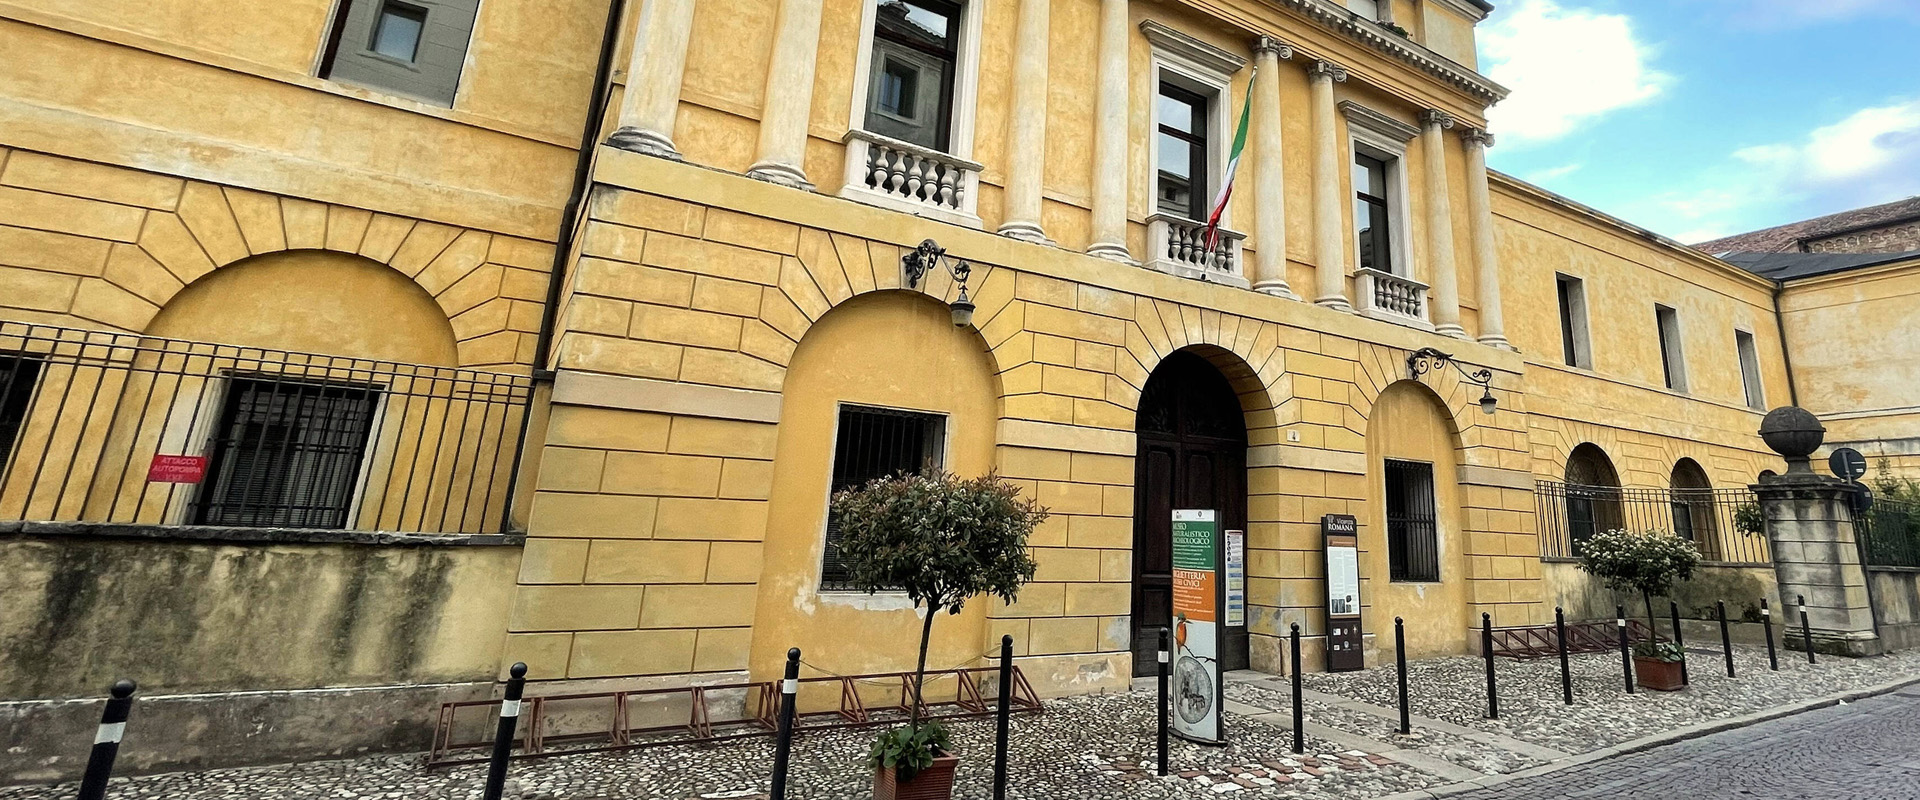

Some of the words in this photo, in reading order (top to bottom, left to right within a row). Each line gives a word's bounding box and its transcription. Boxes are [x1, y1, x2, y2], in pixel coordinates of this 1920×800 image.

[161, 457, 198, 465] ATTACCO
[152, 465, 201, 473] AUTOPOMPA
[1327, 523, 1354, 532] ROMANA
